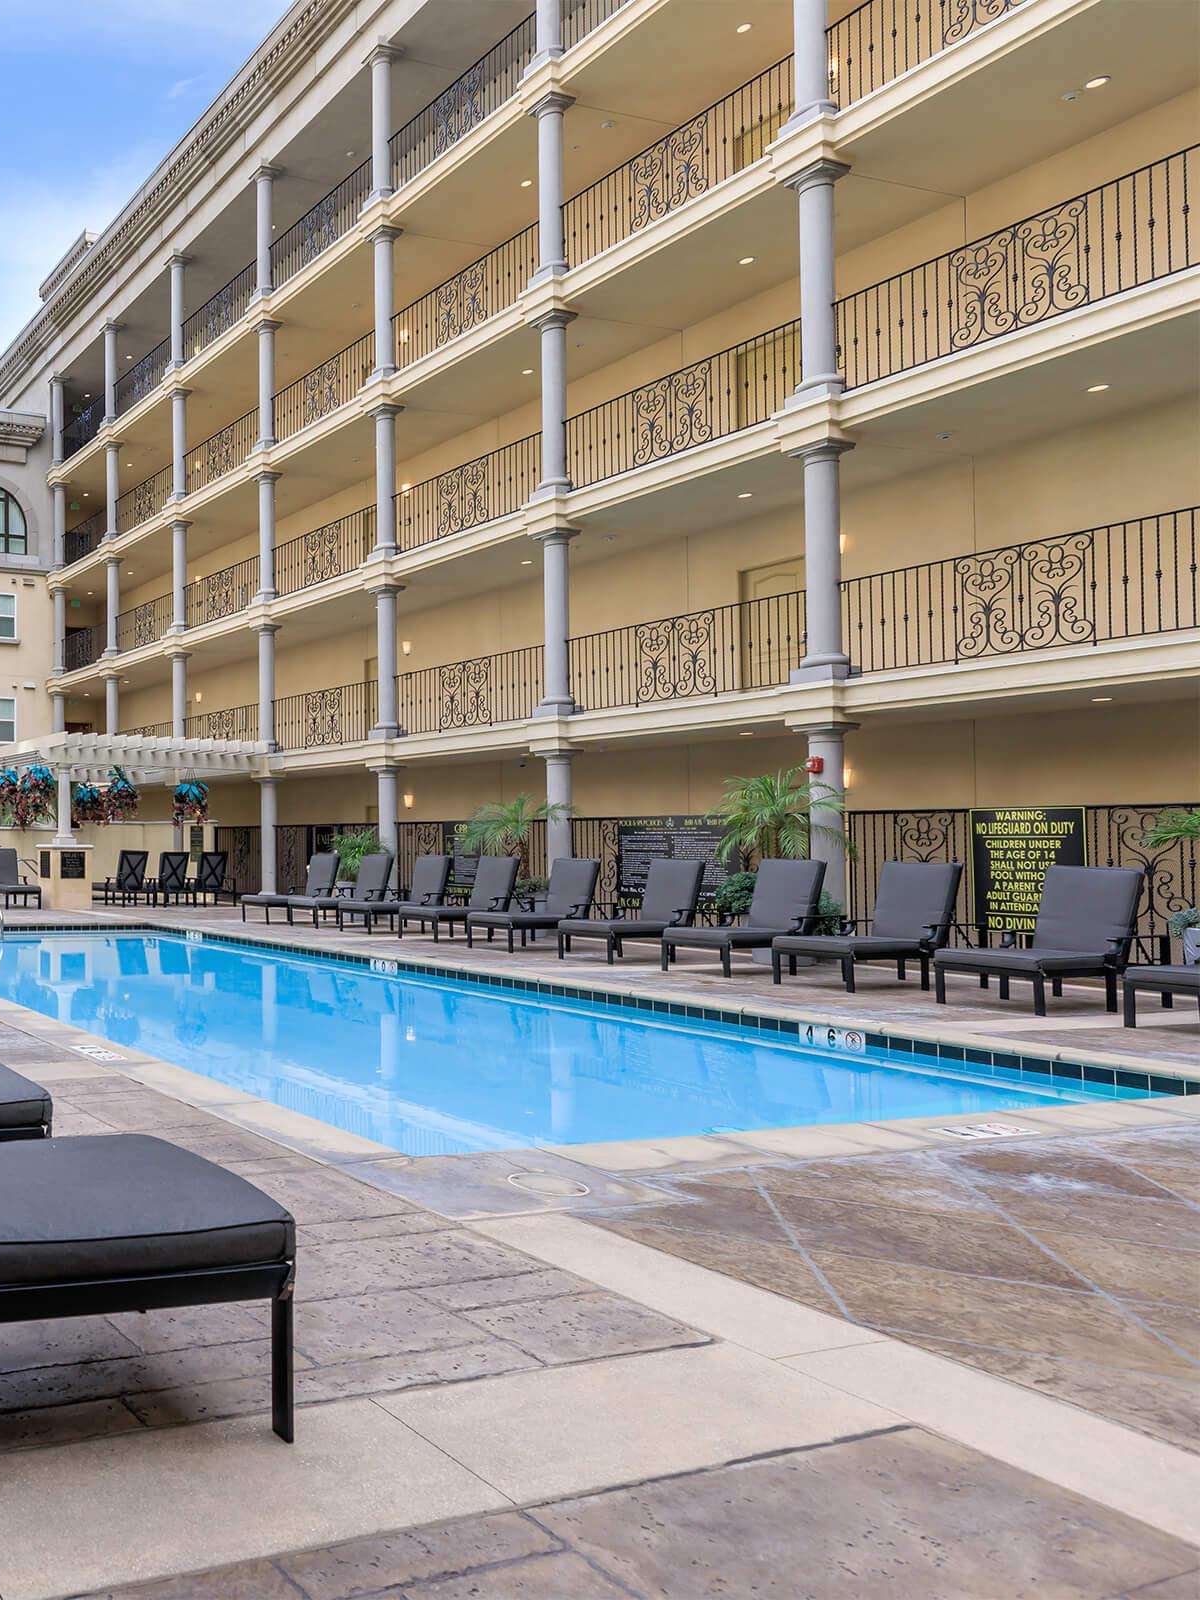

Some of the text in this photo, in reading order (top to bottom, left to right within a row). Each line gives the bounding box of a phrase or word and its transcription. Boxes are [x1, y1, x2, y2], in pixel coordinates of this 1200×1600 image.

[995, 810, 1047, 821] WARNING:
[976, 822, 1074, 834] NO LIFEGUARD ON DUTY
[985, 840, 1061, 849] CHILDREN UNDER
[990, 850, 1056, 859] THE AGE OF 14
[990, 861, 1014, 870] SHALL
[1016, 861, 1036, 870] NOT
[990, 871, 1046, 881] POOL WITHO
[994, 881, 1001, 890] A
[1002, 881, 1036, 891] PARENT
[986, 891, 1042, 901] ADULT GUAR
[990, 902, 1039, 912] IN ATTENDA
[988, 916, 1036, 929] NO DIVIN
[827, 1028, 836, 1048] 6
